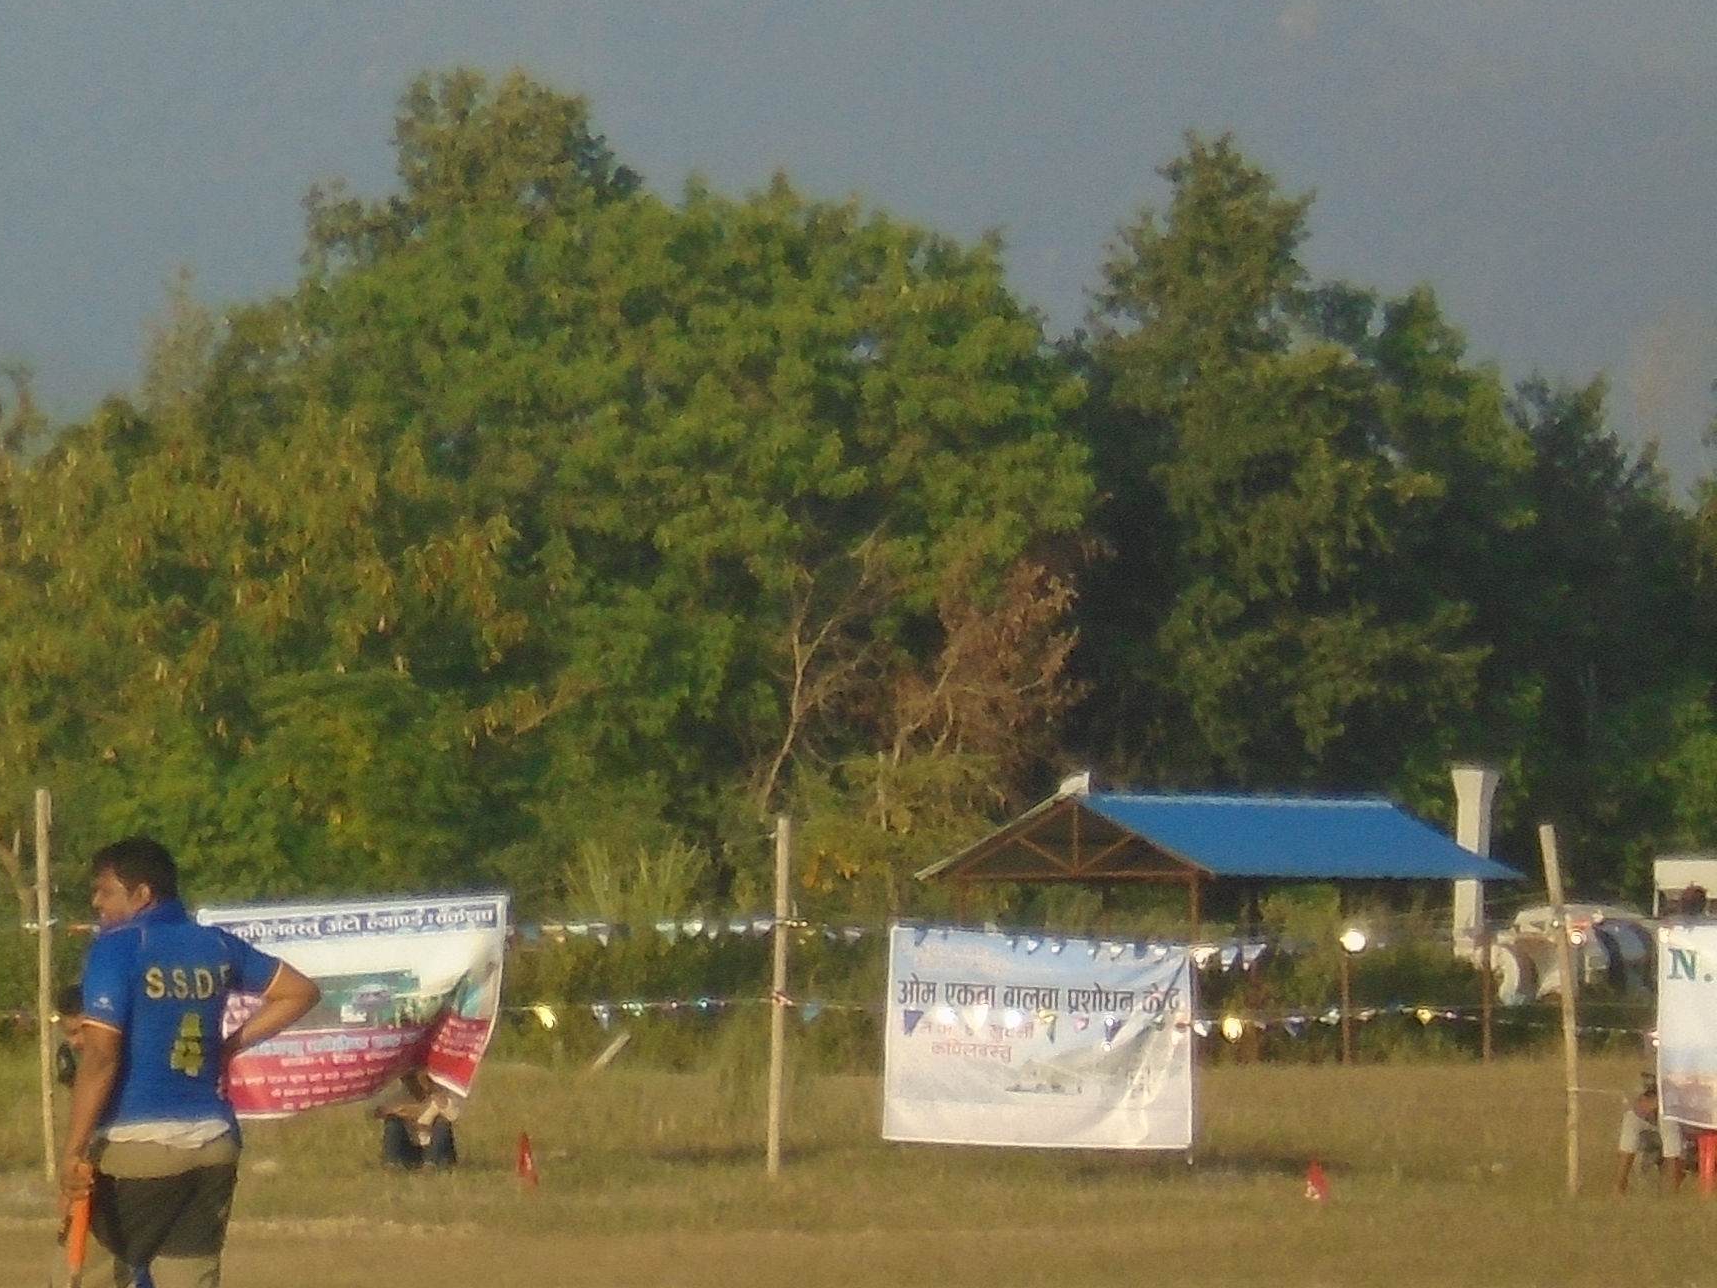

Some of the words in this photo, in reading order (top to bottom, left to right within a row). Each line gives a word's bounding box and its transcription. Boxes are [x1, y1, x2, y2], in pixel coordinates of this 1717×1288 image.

[896, 972, 938, 1006] ओम
[944, 982, 997, 1009] एकता
[170, 1012, 205, 1077] 4
